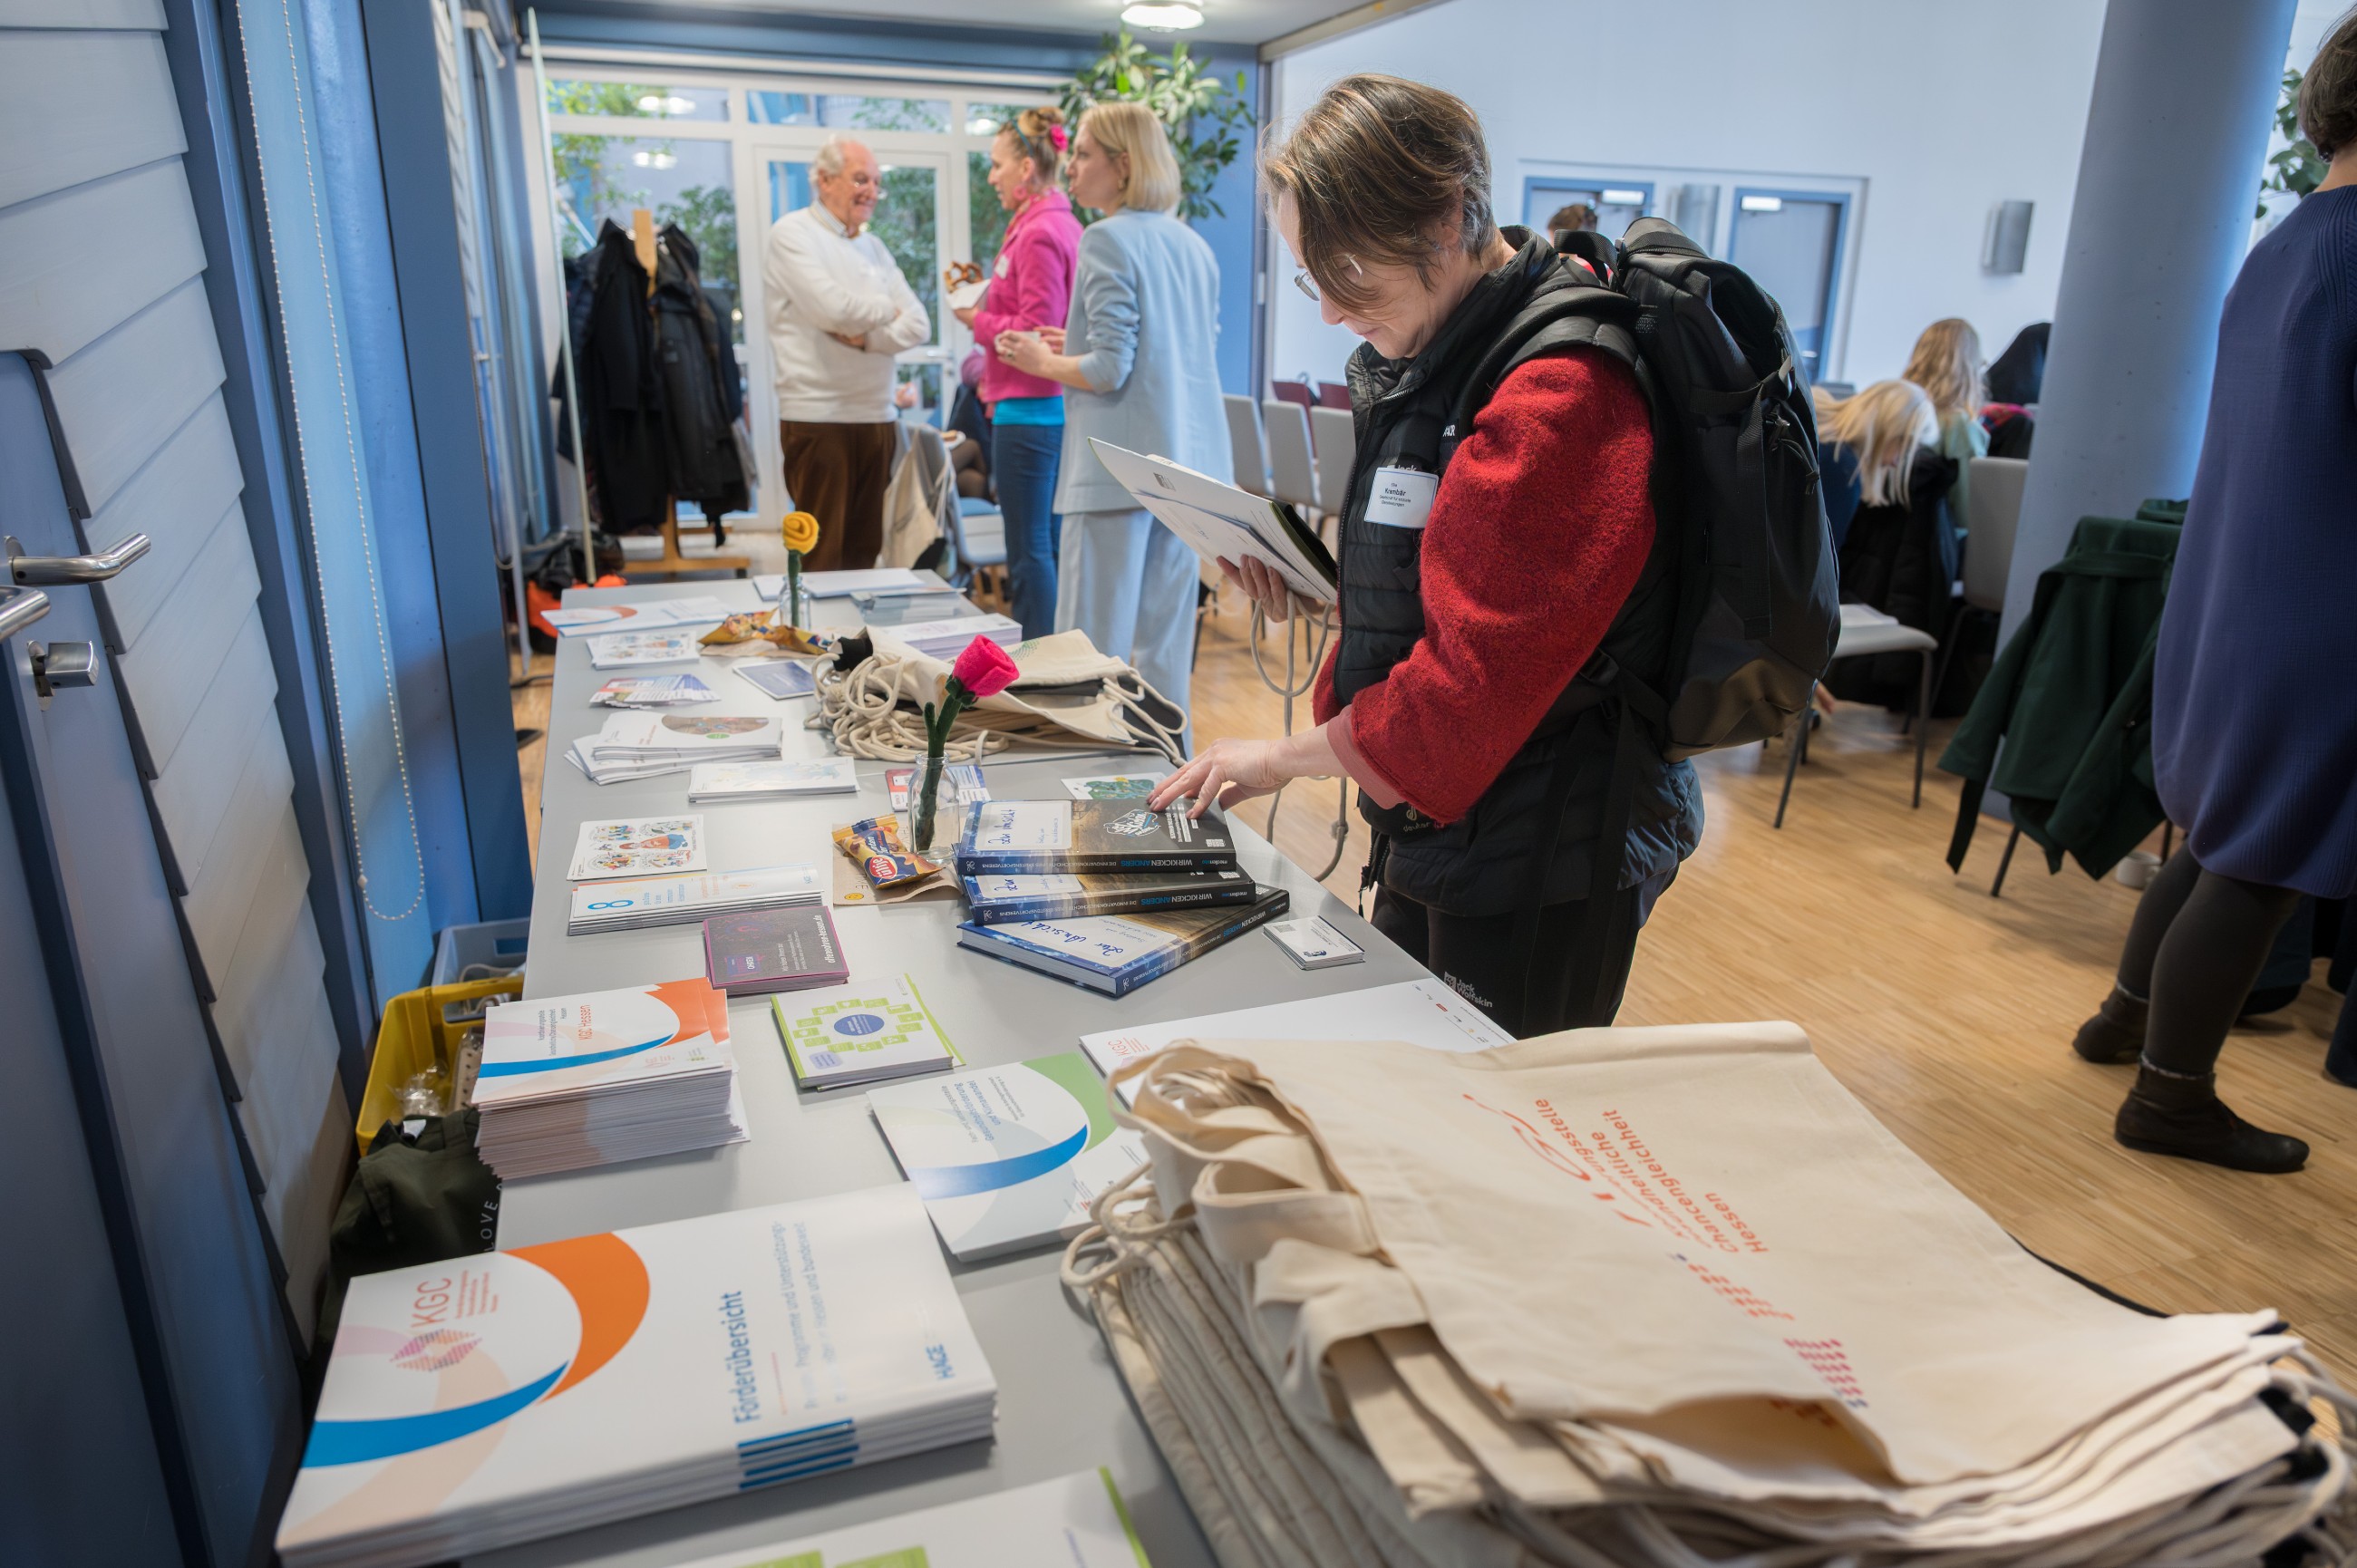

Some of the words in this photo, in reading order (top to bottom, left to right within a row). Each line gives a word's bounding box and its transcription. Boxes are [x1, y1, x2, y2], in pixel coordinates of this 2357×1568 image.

[1141, 896, 1170, 905] ANDERS
[1171, 894, 1198, 903] KICKEN
[1457, 979, 1475, 992] Jack
[1457, 985, 1493, 1008] Wolfskin
[577, 1004, 592, 1026] Hessen
[1108, 1040, 1130, 1057] KGC
[1603, 1109, 1739, 1253] Chancengleichheit
[1705, 1192, 1770, 1254] Hessen
[410, 1277, 451, 1328] KGC
[718, 1291, 761, 1424] Förderübersicht
